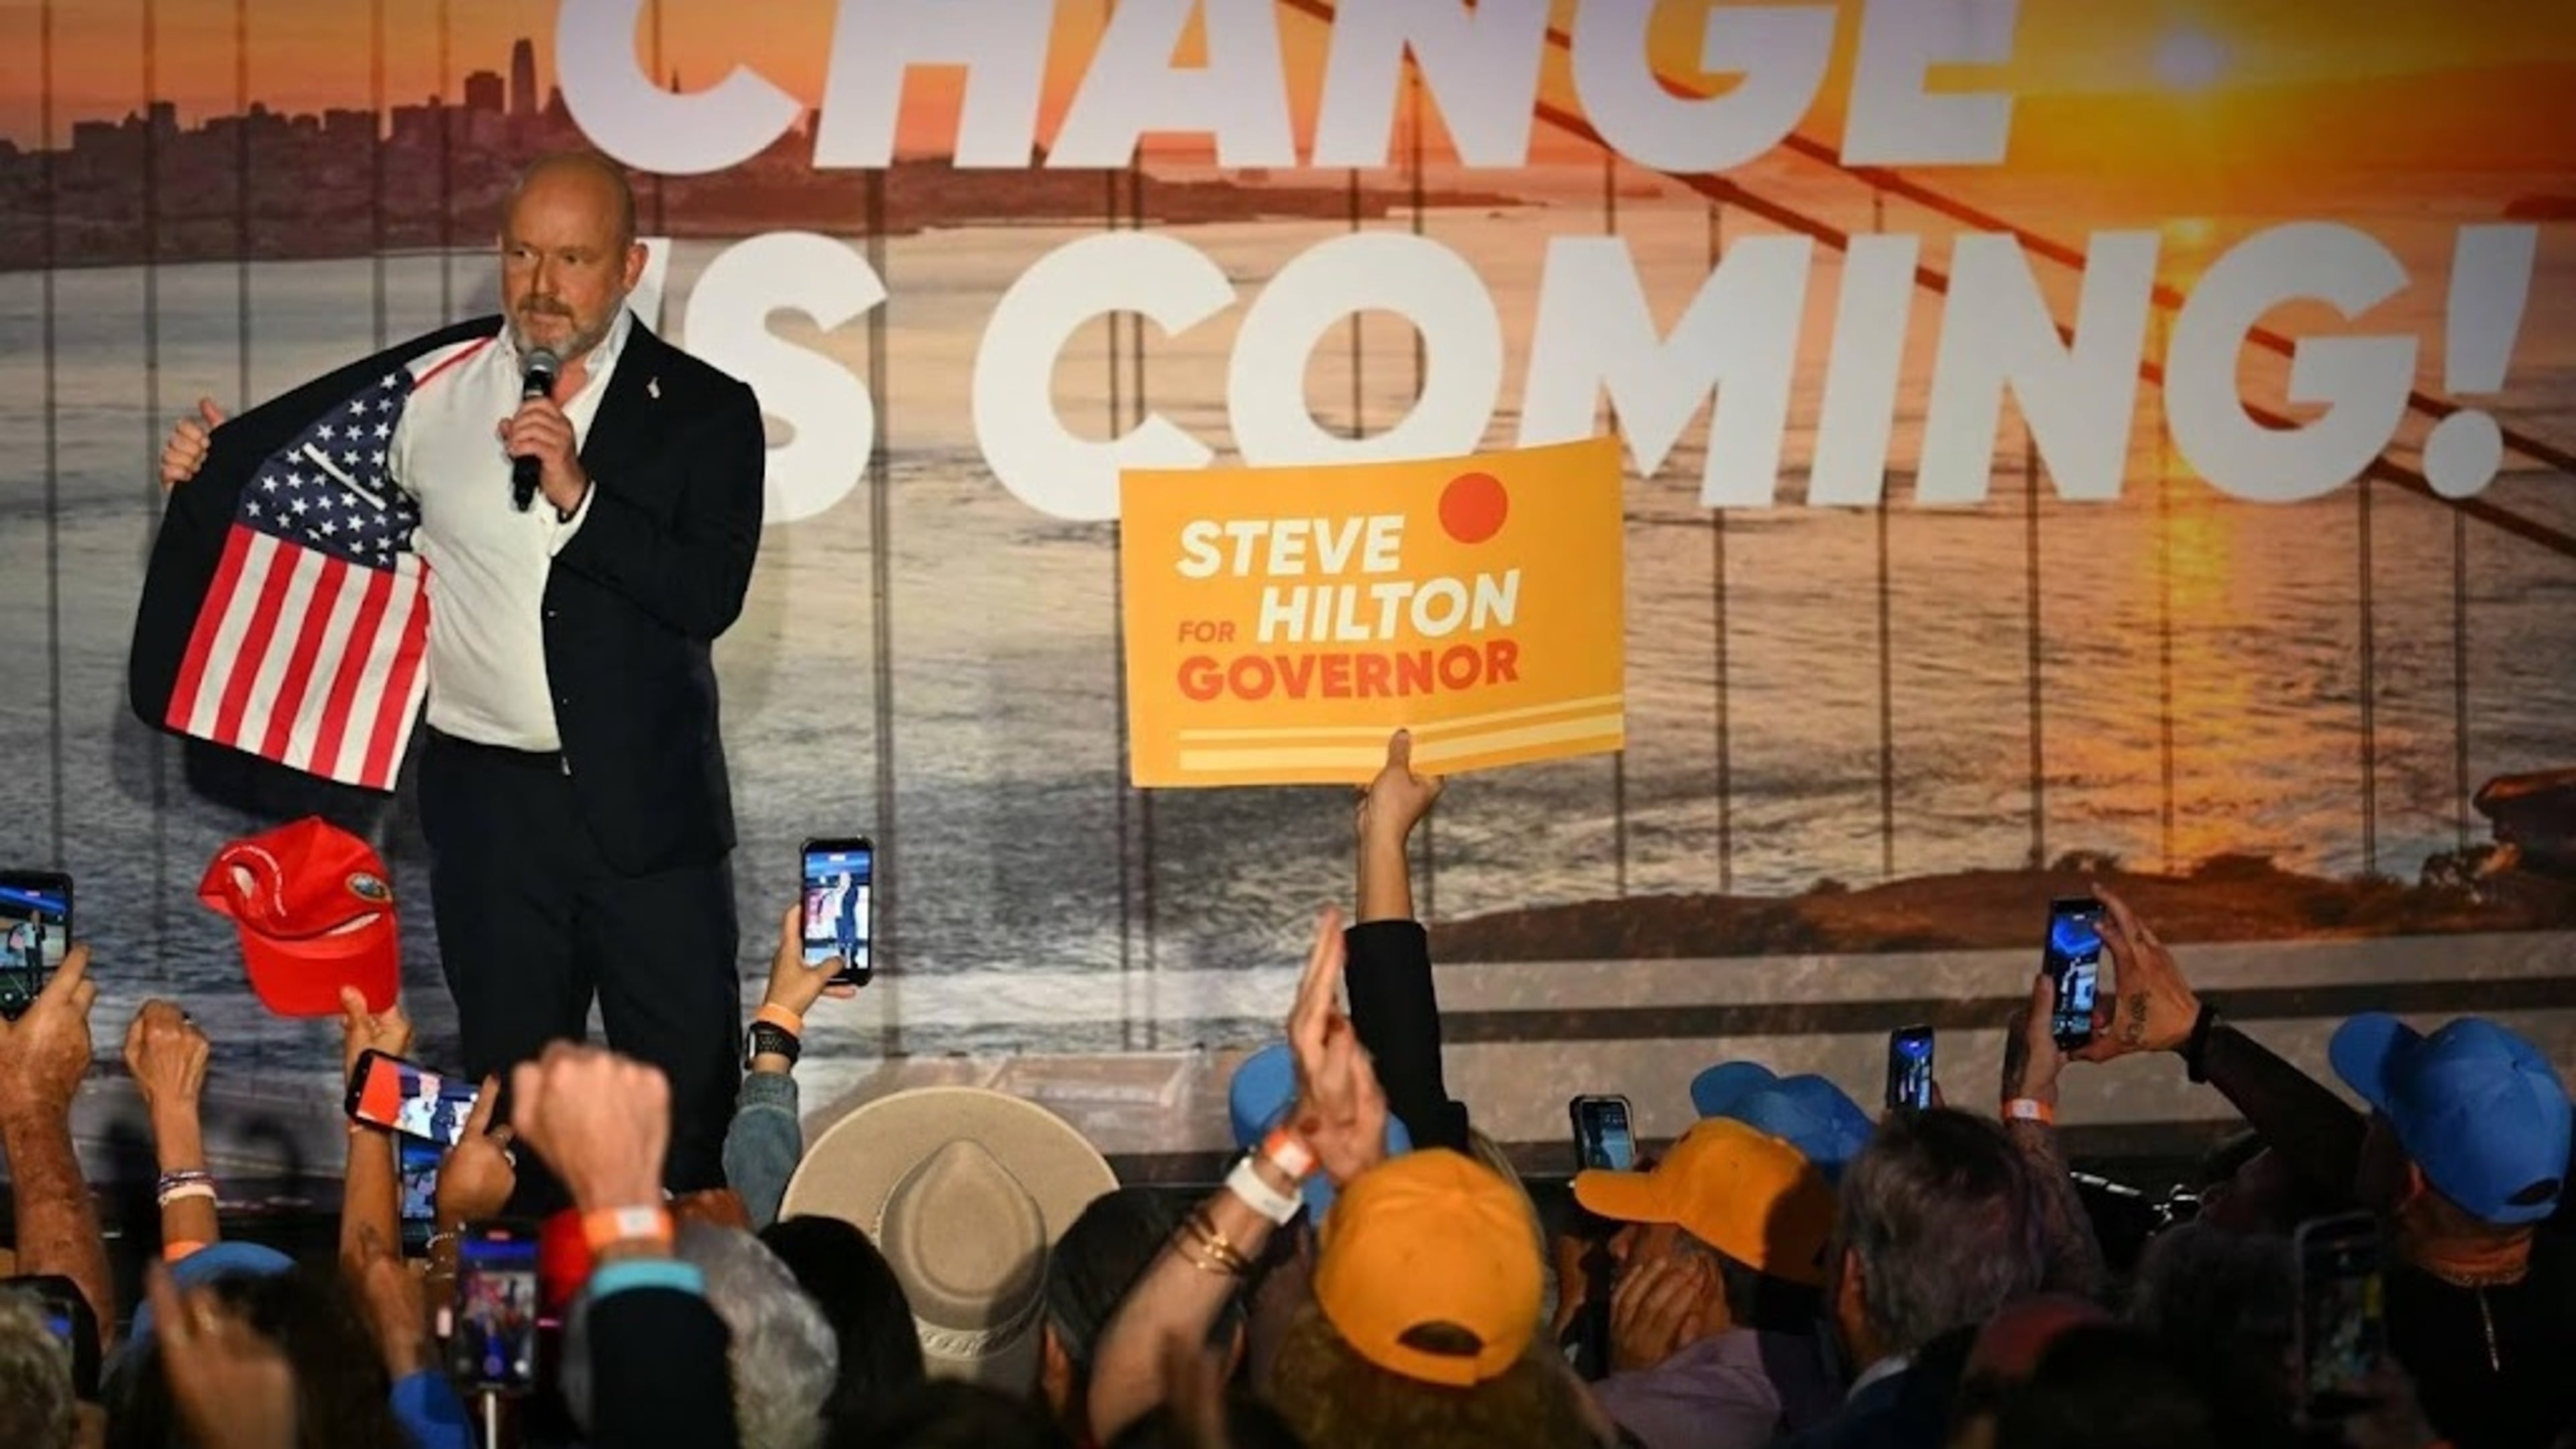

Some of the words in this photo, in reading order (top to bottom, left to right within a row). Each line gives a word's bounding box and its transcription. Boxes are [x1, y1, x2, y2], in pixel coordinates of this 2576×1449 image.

[555, 0, 2017, 175] CHANGE
[627, 230, 888, 525] S
[972, 221, 2538, 521] COMING!
[1177, 515, 1405, 578] STEVE
[1178, 621, 1236, 643] FOR
[1257, 570, 1520, 643] HILTON
[1177, 639, 1519, 702] GOVERNOR
